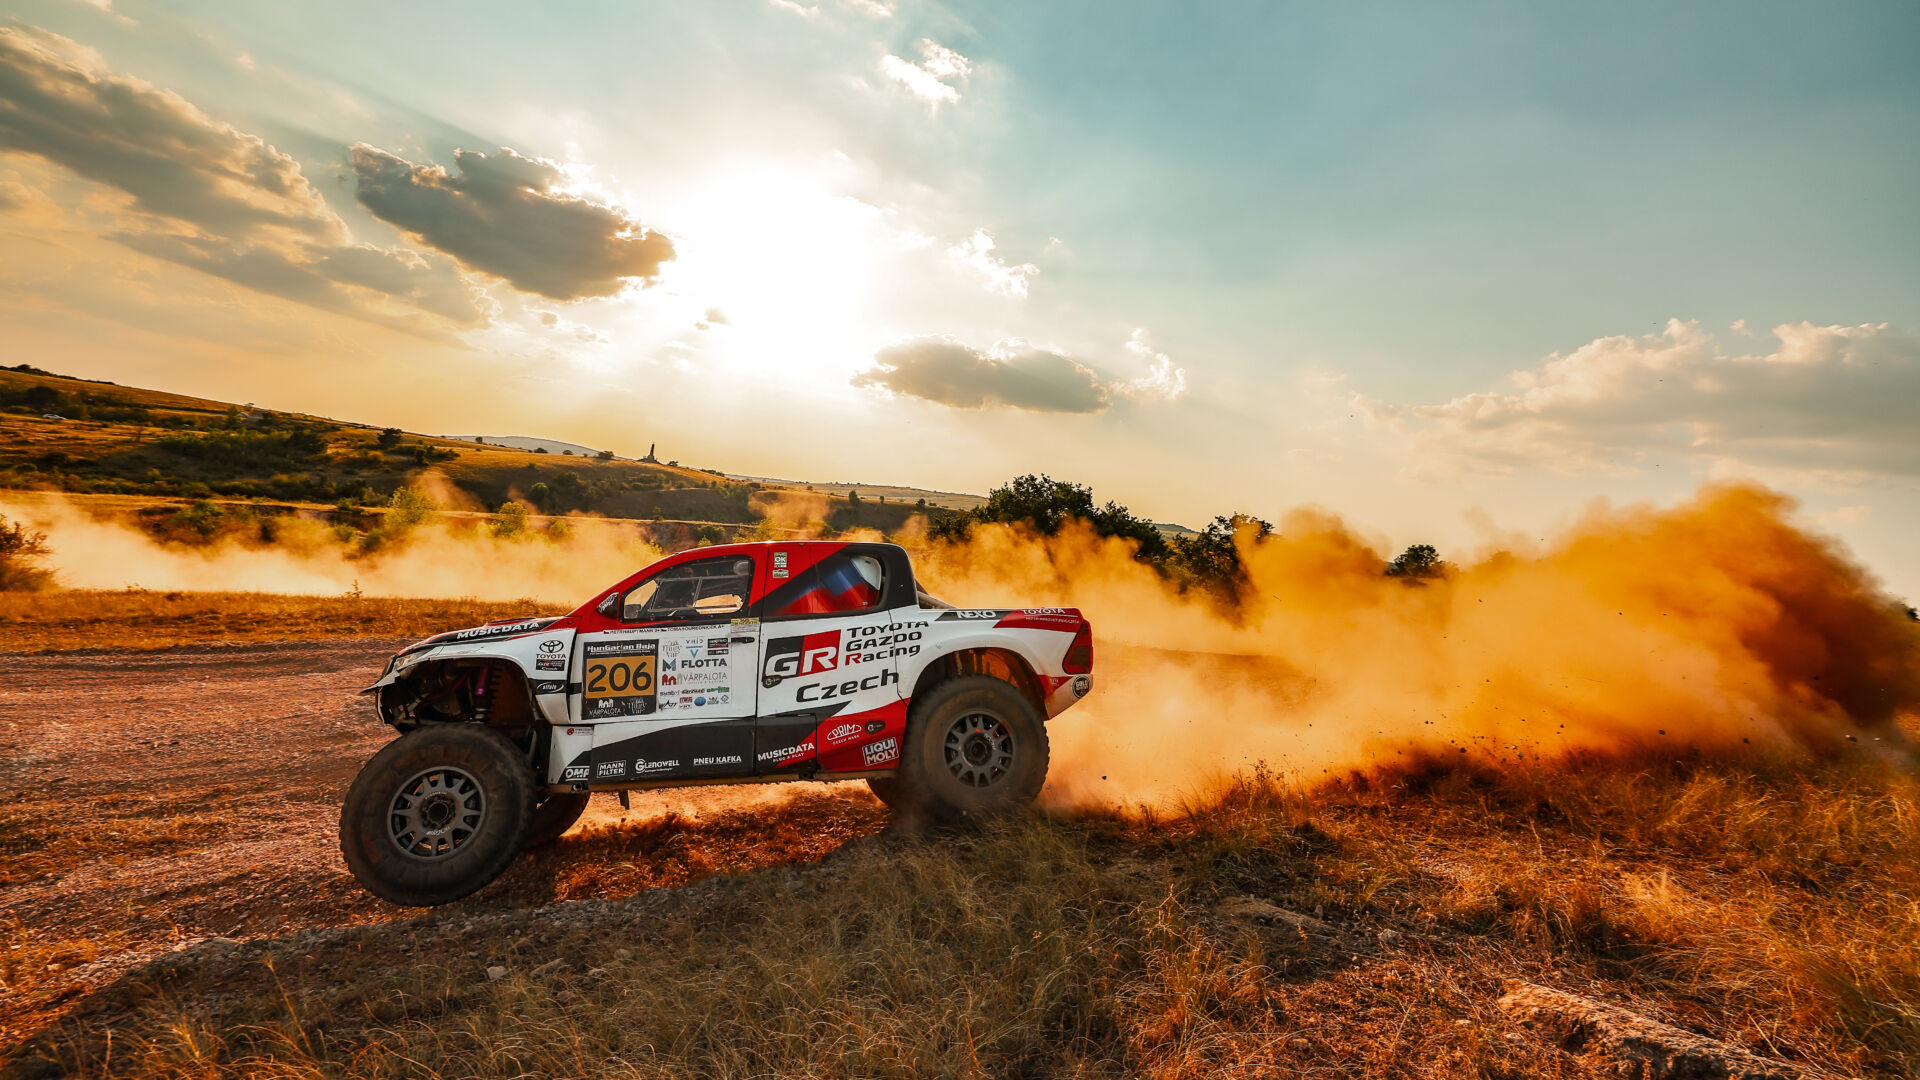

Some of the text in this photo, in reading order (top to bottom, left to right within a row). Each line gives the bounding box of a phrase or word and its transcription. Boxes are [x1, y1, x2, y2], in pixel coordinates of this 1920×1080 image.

[957, 610, 997, 619] NEXO
[1021, 607, 1066, 615] TOYOTA
[456, 622, 540, 640] MUSICDATA
[846, 621, 929, 638] TOYOTA
[845, 631, 923, 652] GAZOO
[681, 658, 728, 669] FLOTTA
[765, 646, 837, 677] GR
[844, 645, 921, 666] Racing
[588, 662, 652, 693] 206
[796, 668, 899, 703] Czech
[831, 724, 856, 738] PRIM
[757, 742, 815, 762] MUSICDATA
[864, 738, 896, 756] LIQUI
[716, 755, 742, 764] KAFKA
[866, 748, 897, 765] MOLY
[599, 762, 625, 770] MANN
[599, 768, 624, 776] FILTER
